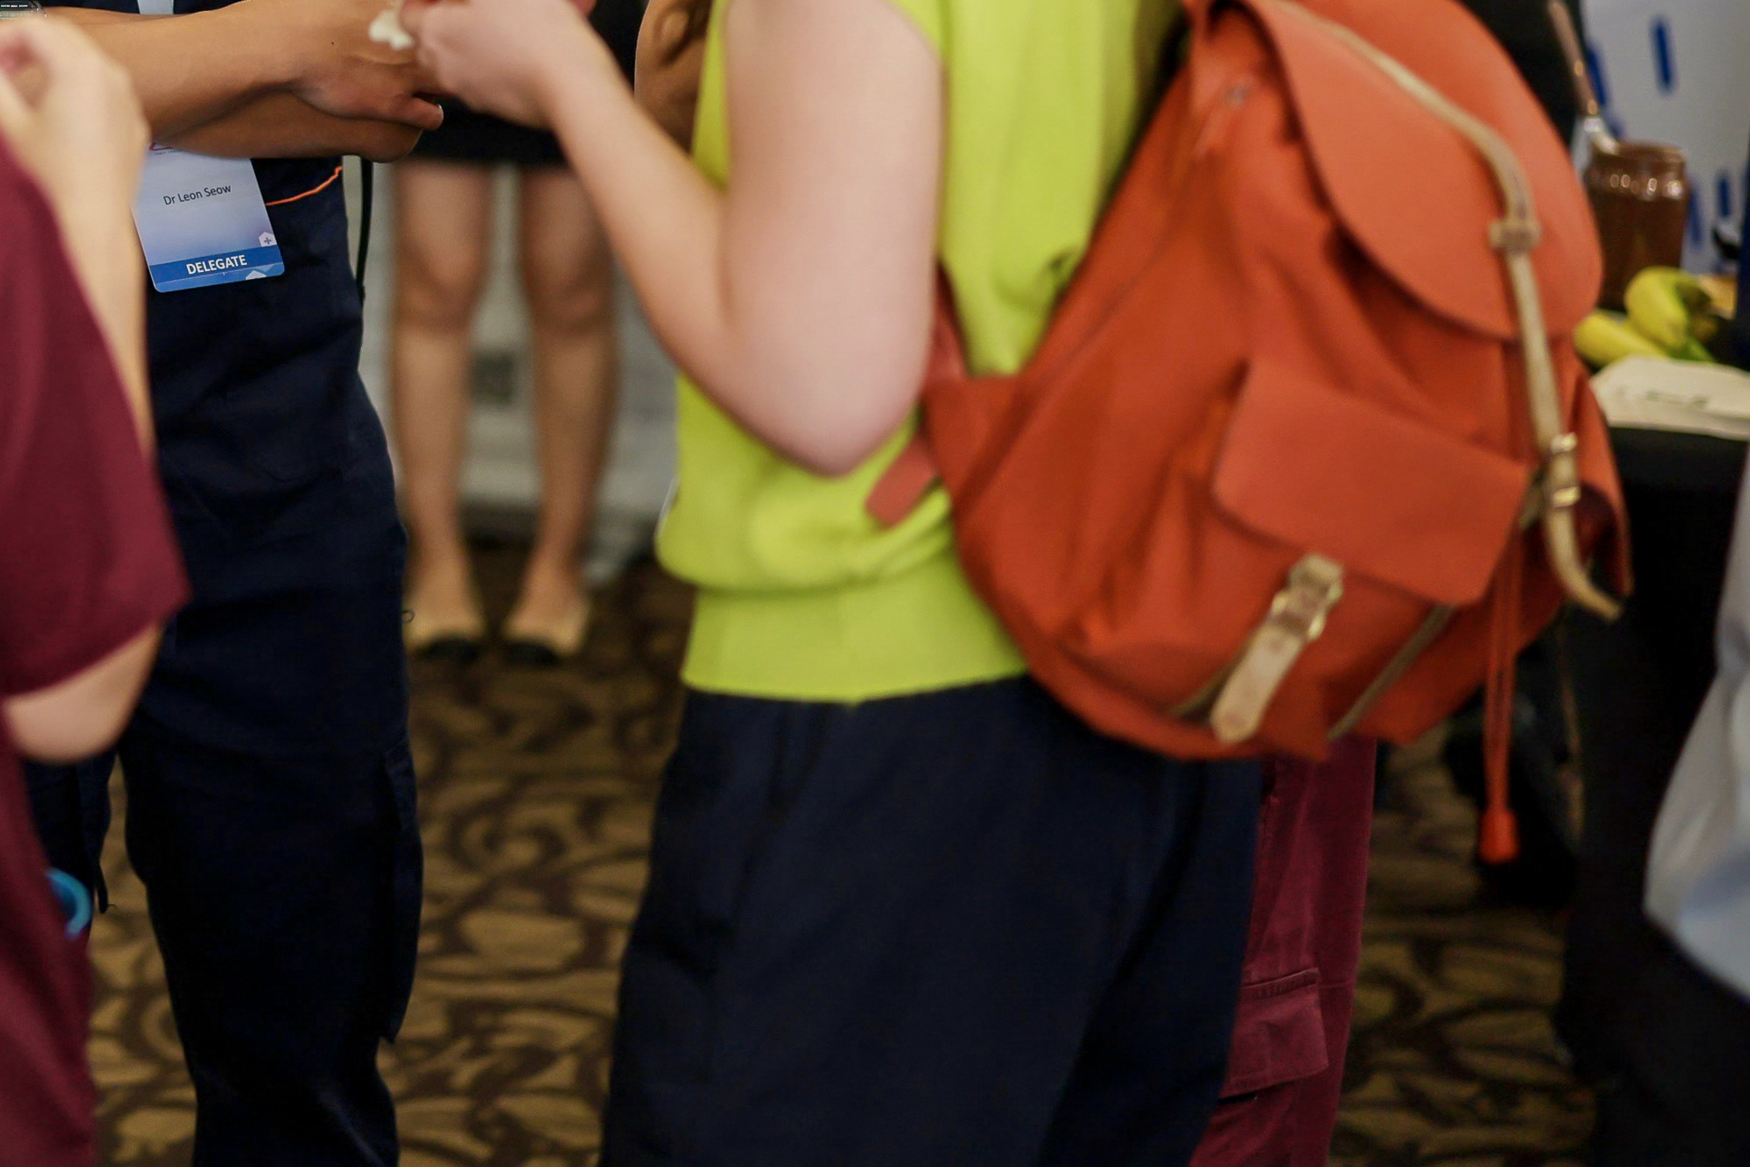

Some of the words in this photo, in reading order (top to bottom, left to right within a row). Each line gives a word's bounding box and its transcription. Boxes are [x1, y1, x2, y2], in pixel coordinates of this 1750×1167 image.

[163, 195, 175, 205] Dr
[177, 190, 203, 203] Leon
[203, 185, 231, 197] Seow
[186, 255, 248, 275] DELEGATE
